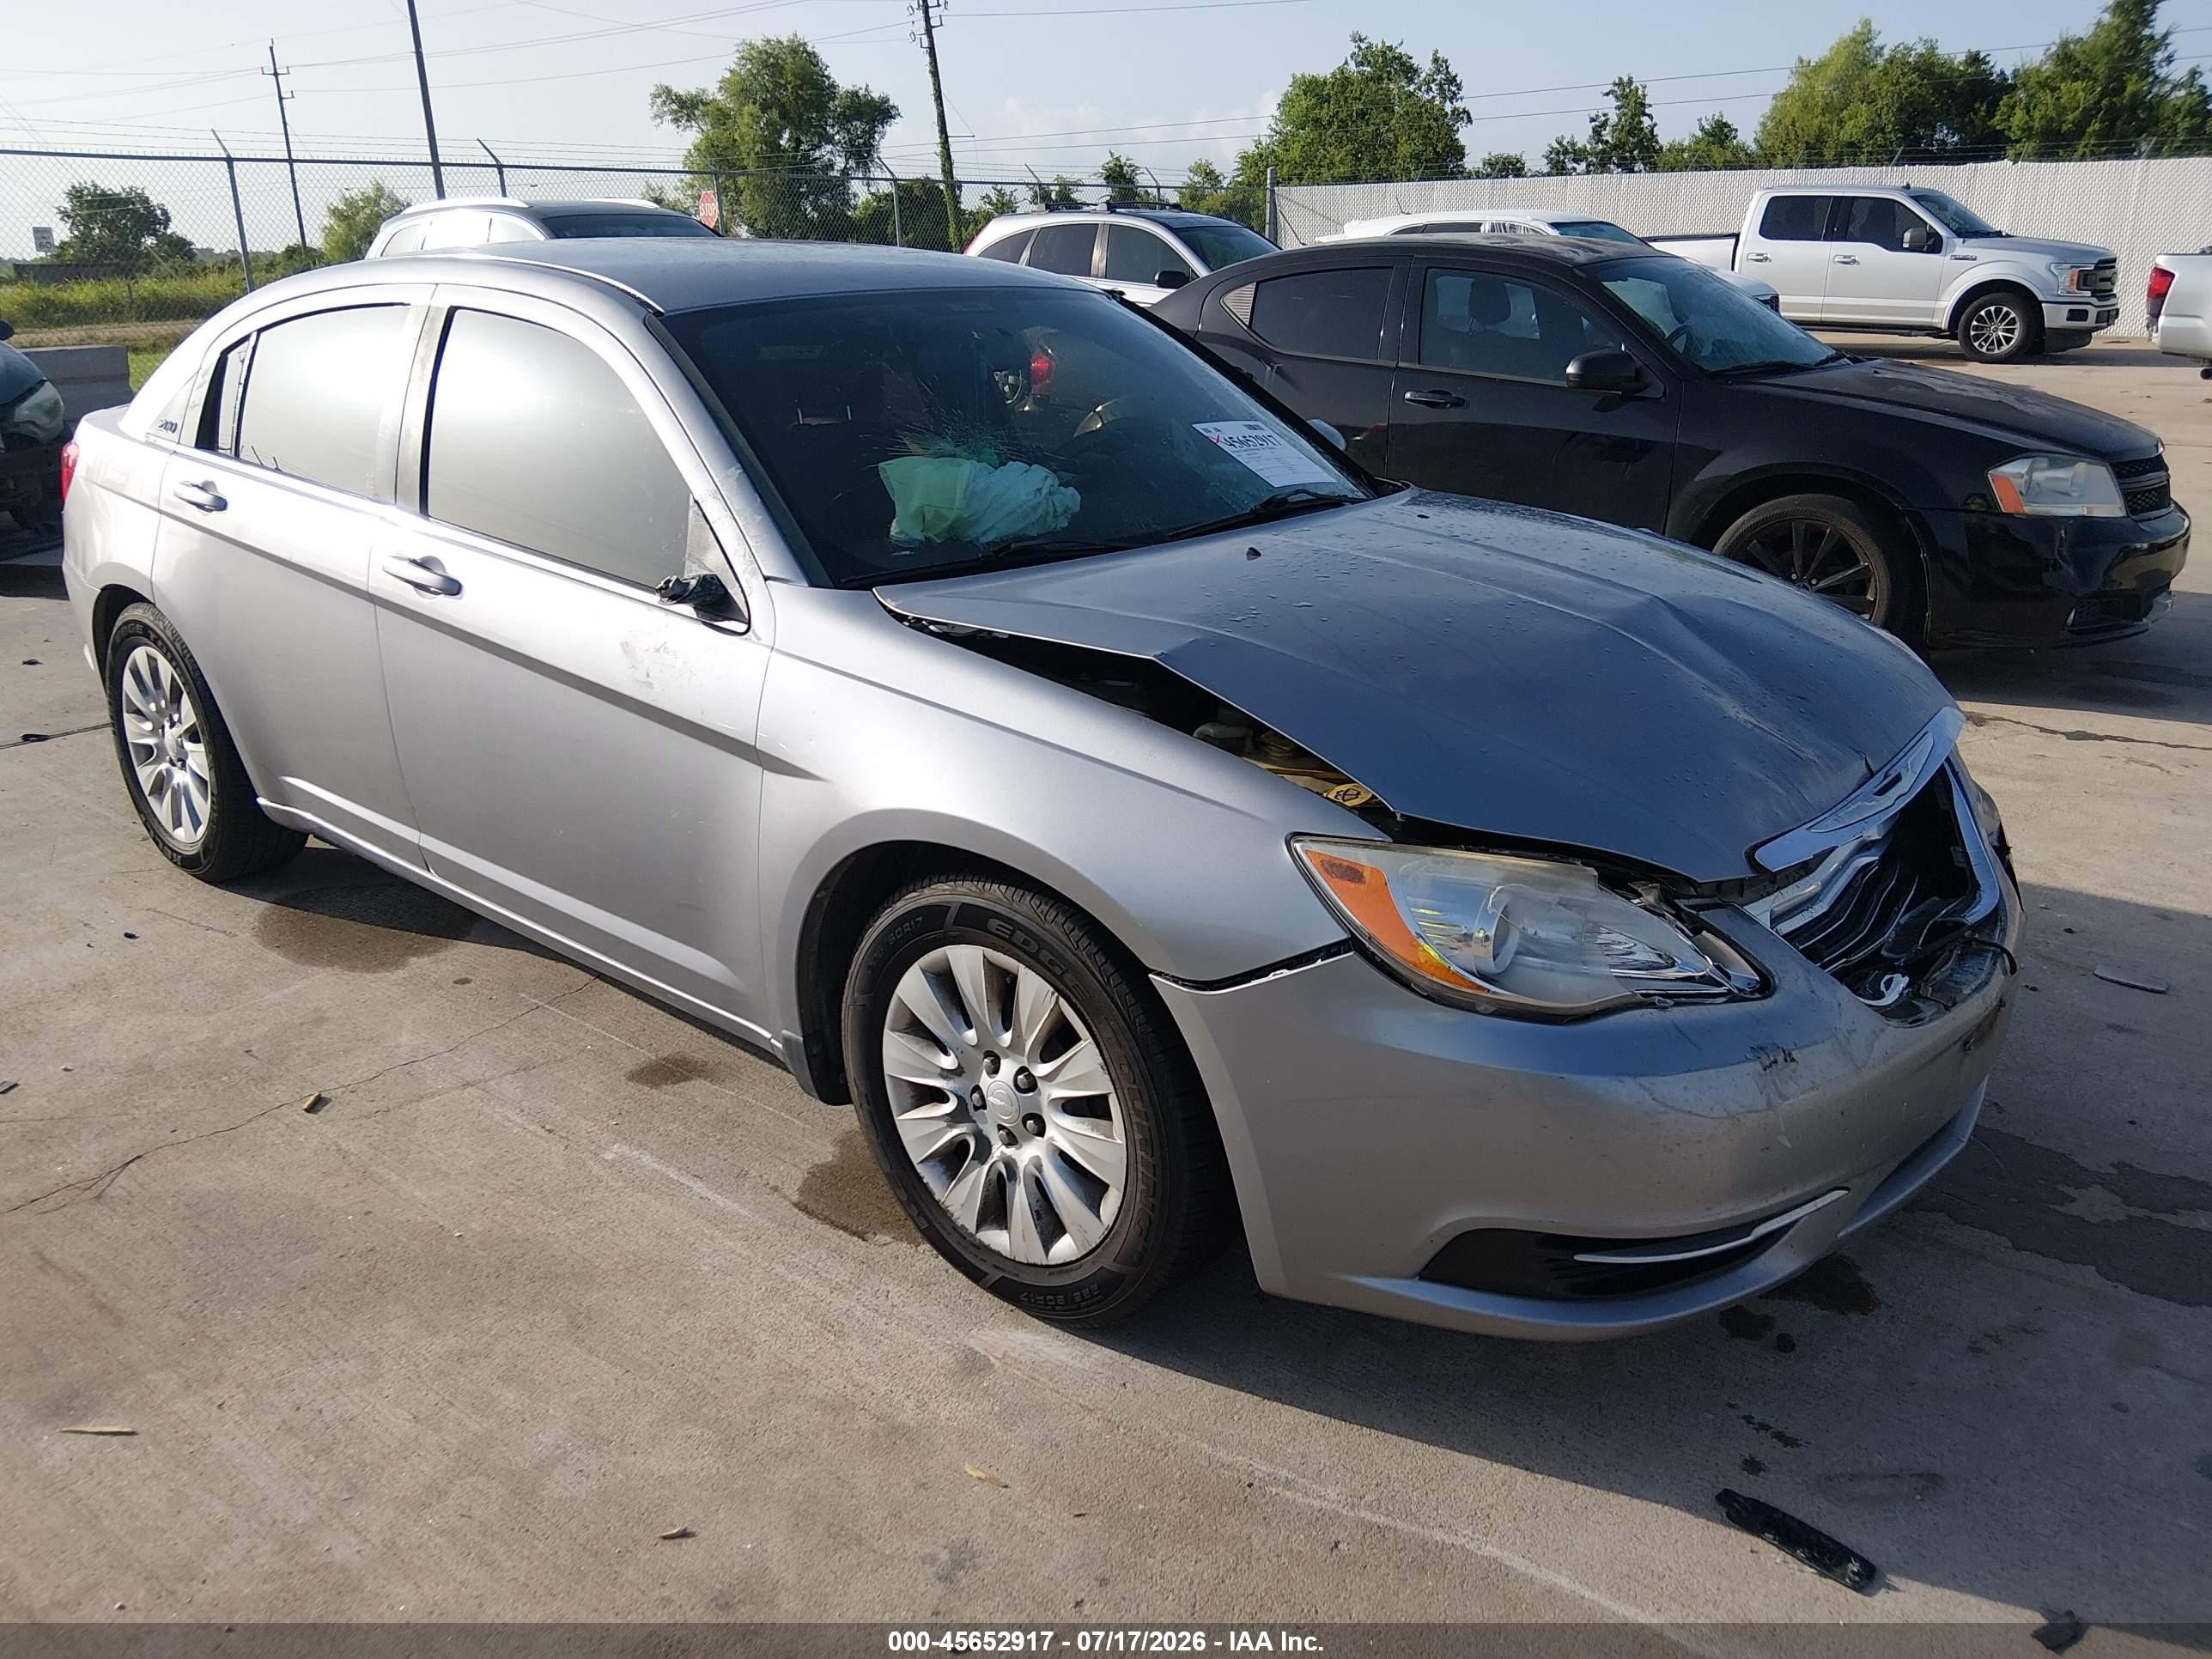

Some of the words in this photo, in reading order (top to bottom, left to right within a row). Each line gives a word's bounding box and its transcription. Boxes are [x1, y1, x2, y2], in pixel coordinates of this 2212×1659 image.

[701, 203, 716, 216] STOP
[1223, 434, 1282, 448] 45652917
[988, 917, 1091, 1002] EDGE
